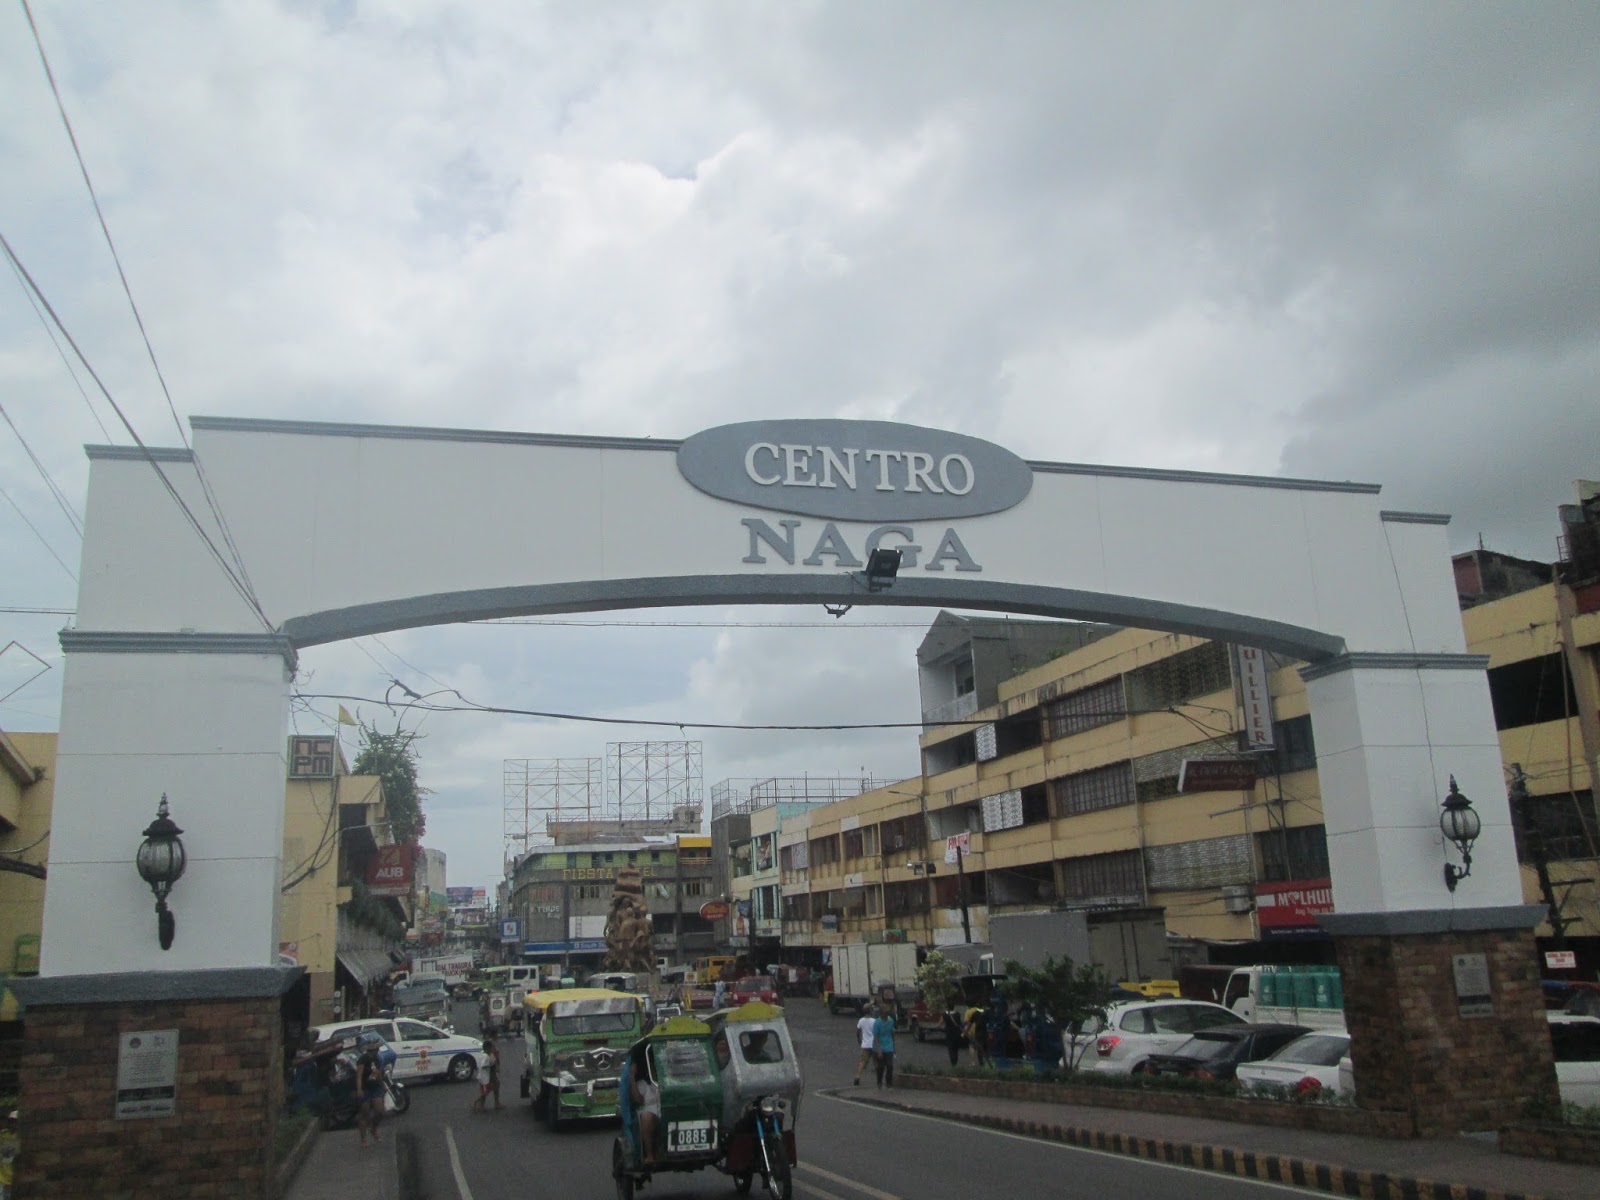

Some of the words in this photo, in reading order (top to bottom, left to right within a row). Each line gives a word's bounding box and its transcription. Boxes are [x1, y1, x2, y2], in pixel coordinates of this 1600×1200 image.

[744, 442, 975, 496] CENTRO
[741, 518, 982, 572] NAGA
[1243, 649, 1267, 741] UILLIER
[375, 867, 404, 878] AUB
[562, 868, 614, 880] FIESTA
[1300, 888, 1333, 906] LHUI
[678, 1129, 708, 1145] 0885
